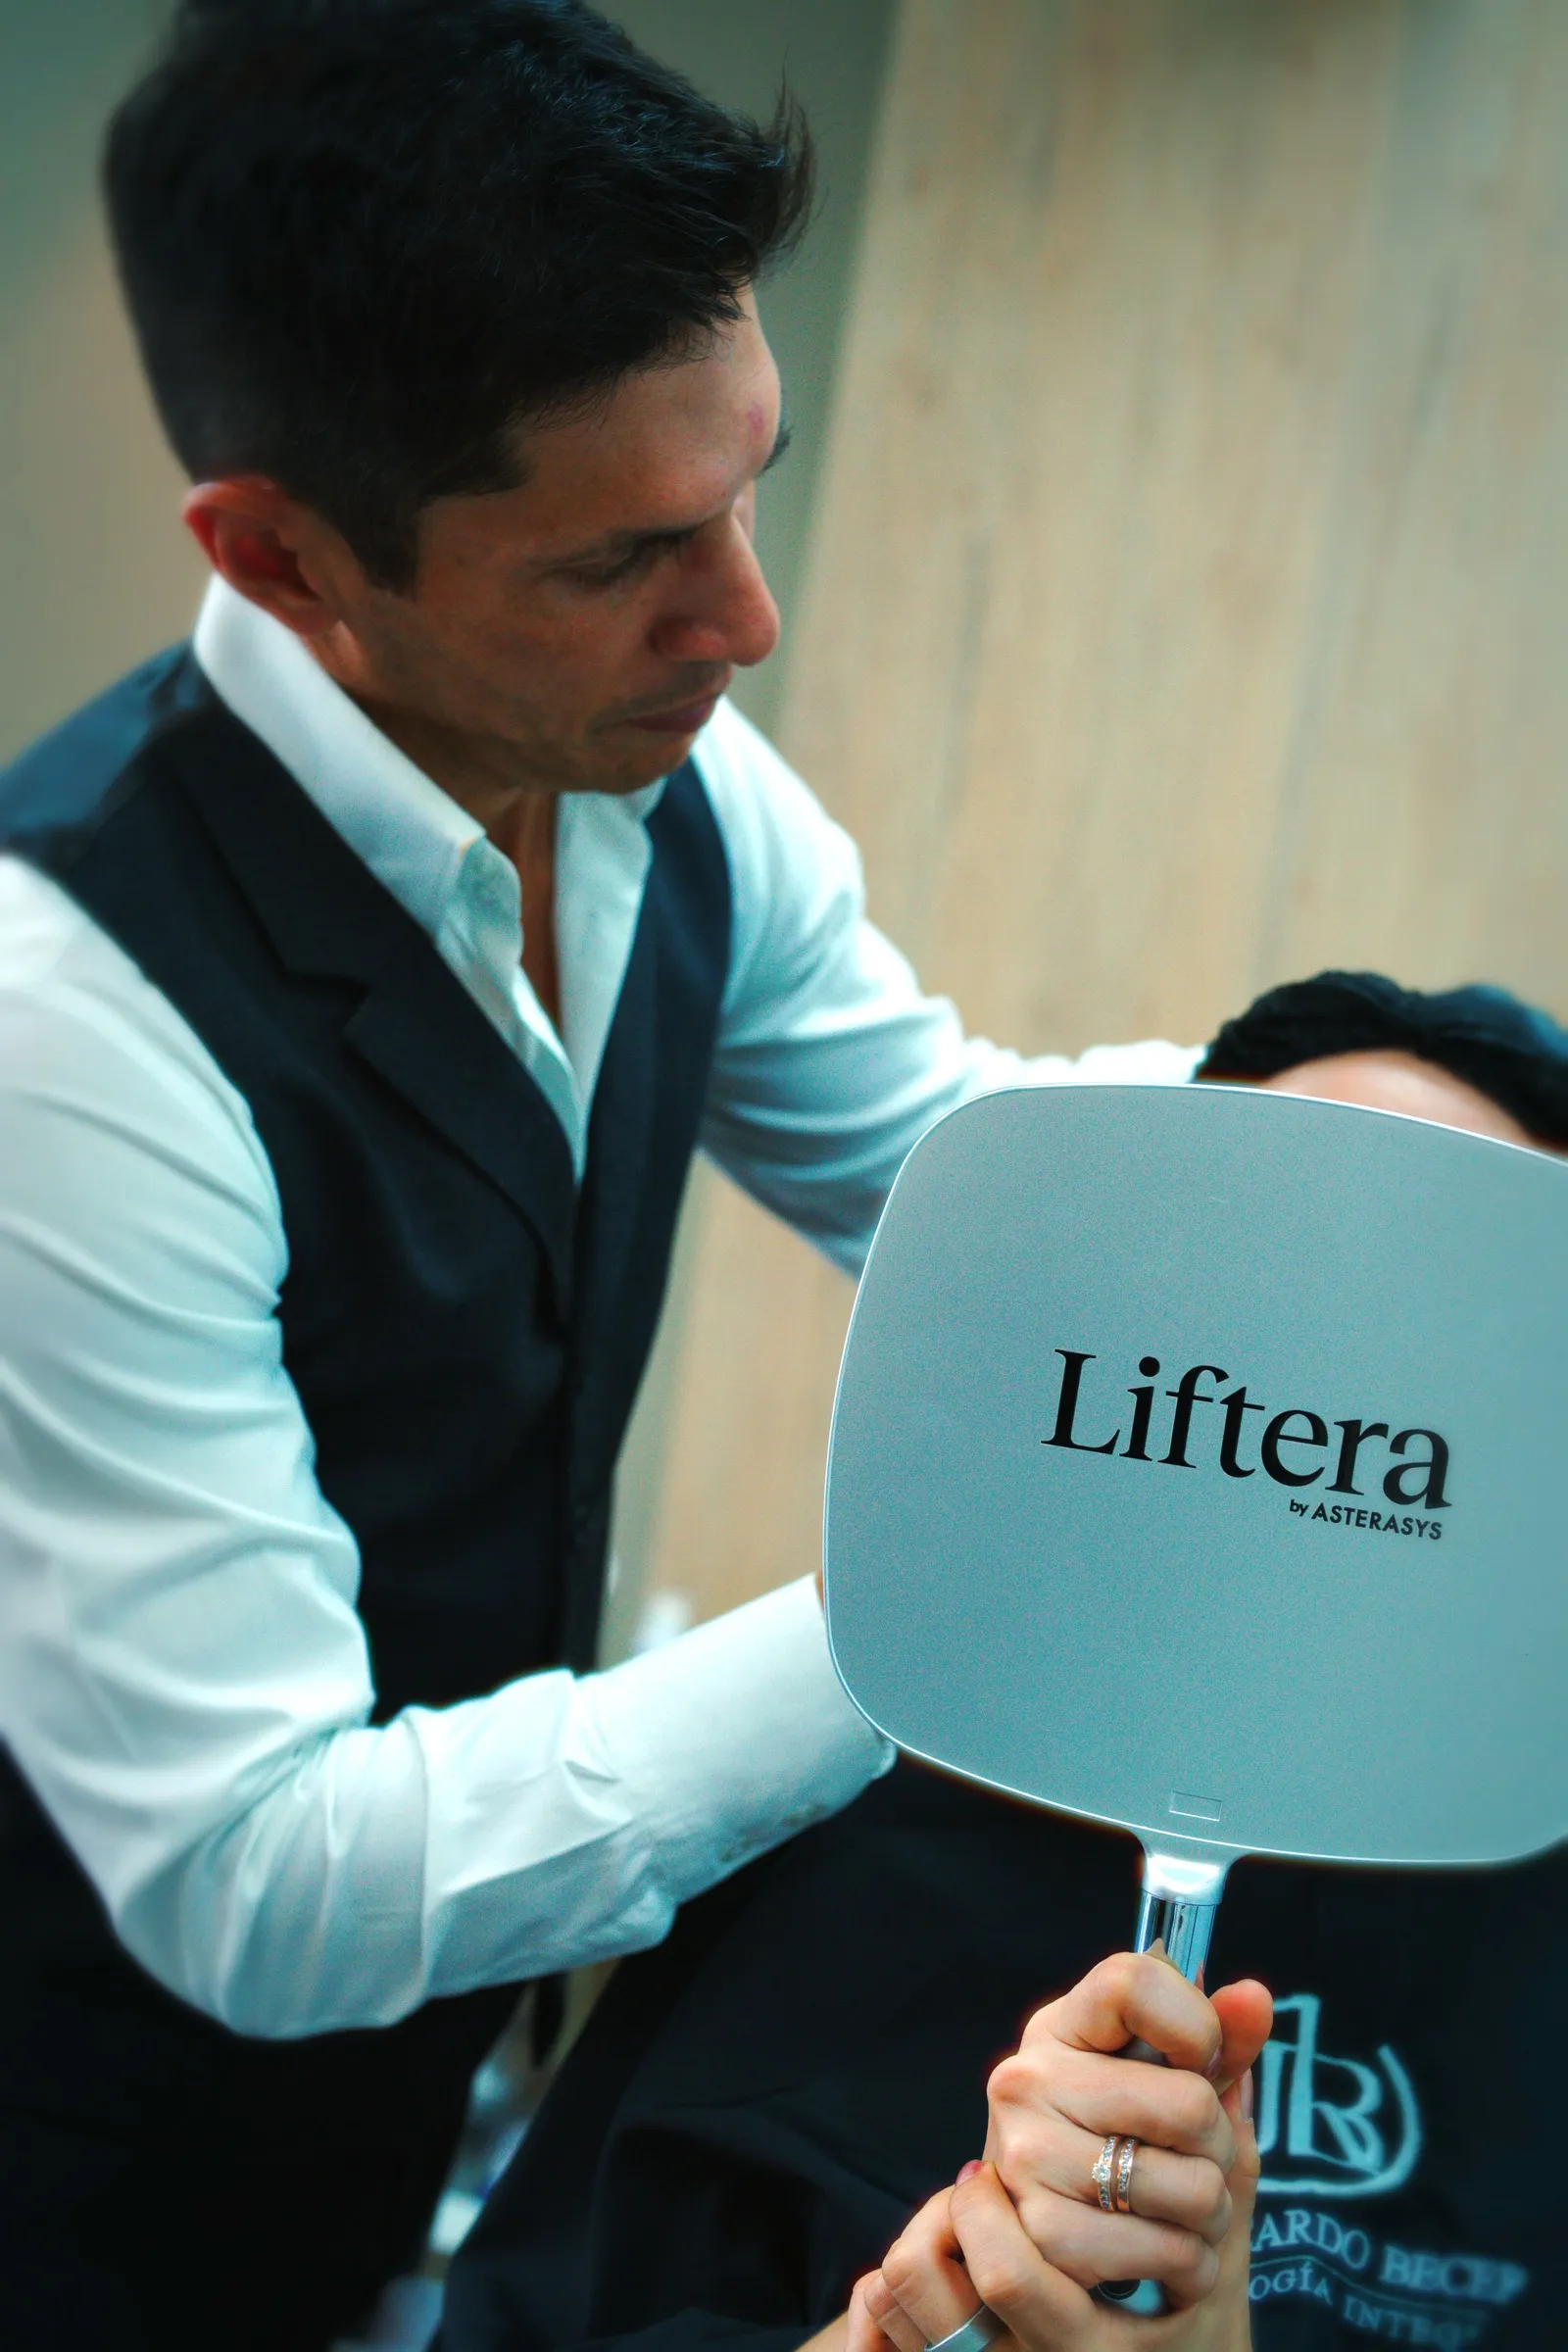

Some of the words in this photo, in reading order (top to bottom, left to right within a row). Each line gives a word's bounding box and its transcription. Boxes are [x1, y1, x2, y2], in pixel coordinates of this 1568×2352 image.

[1041, 1348, 1452, 1510] Liftera
[1290, 1498, 1309, 1517] by
[1311, 1501, 1444, 1541] ASTERASYS
[1250, 2208, 1370, 2270] ARDO
